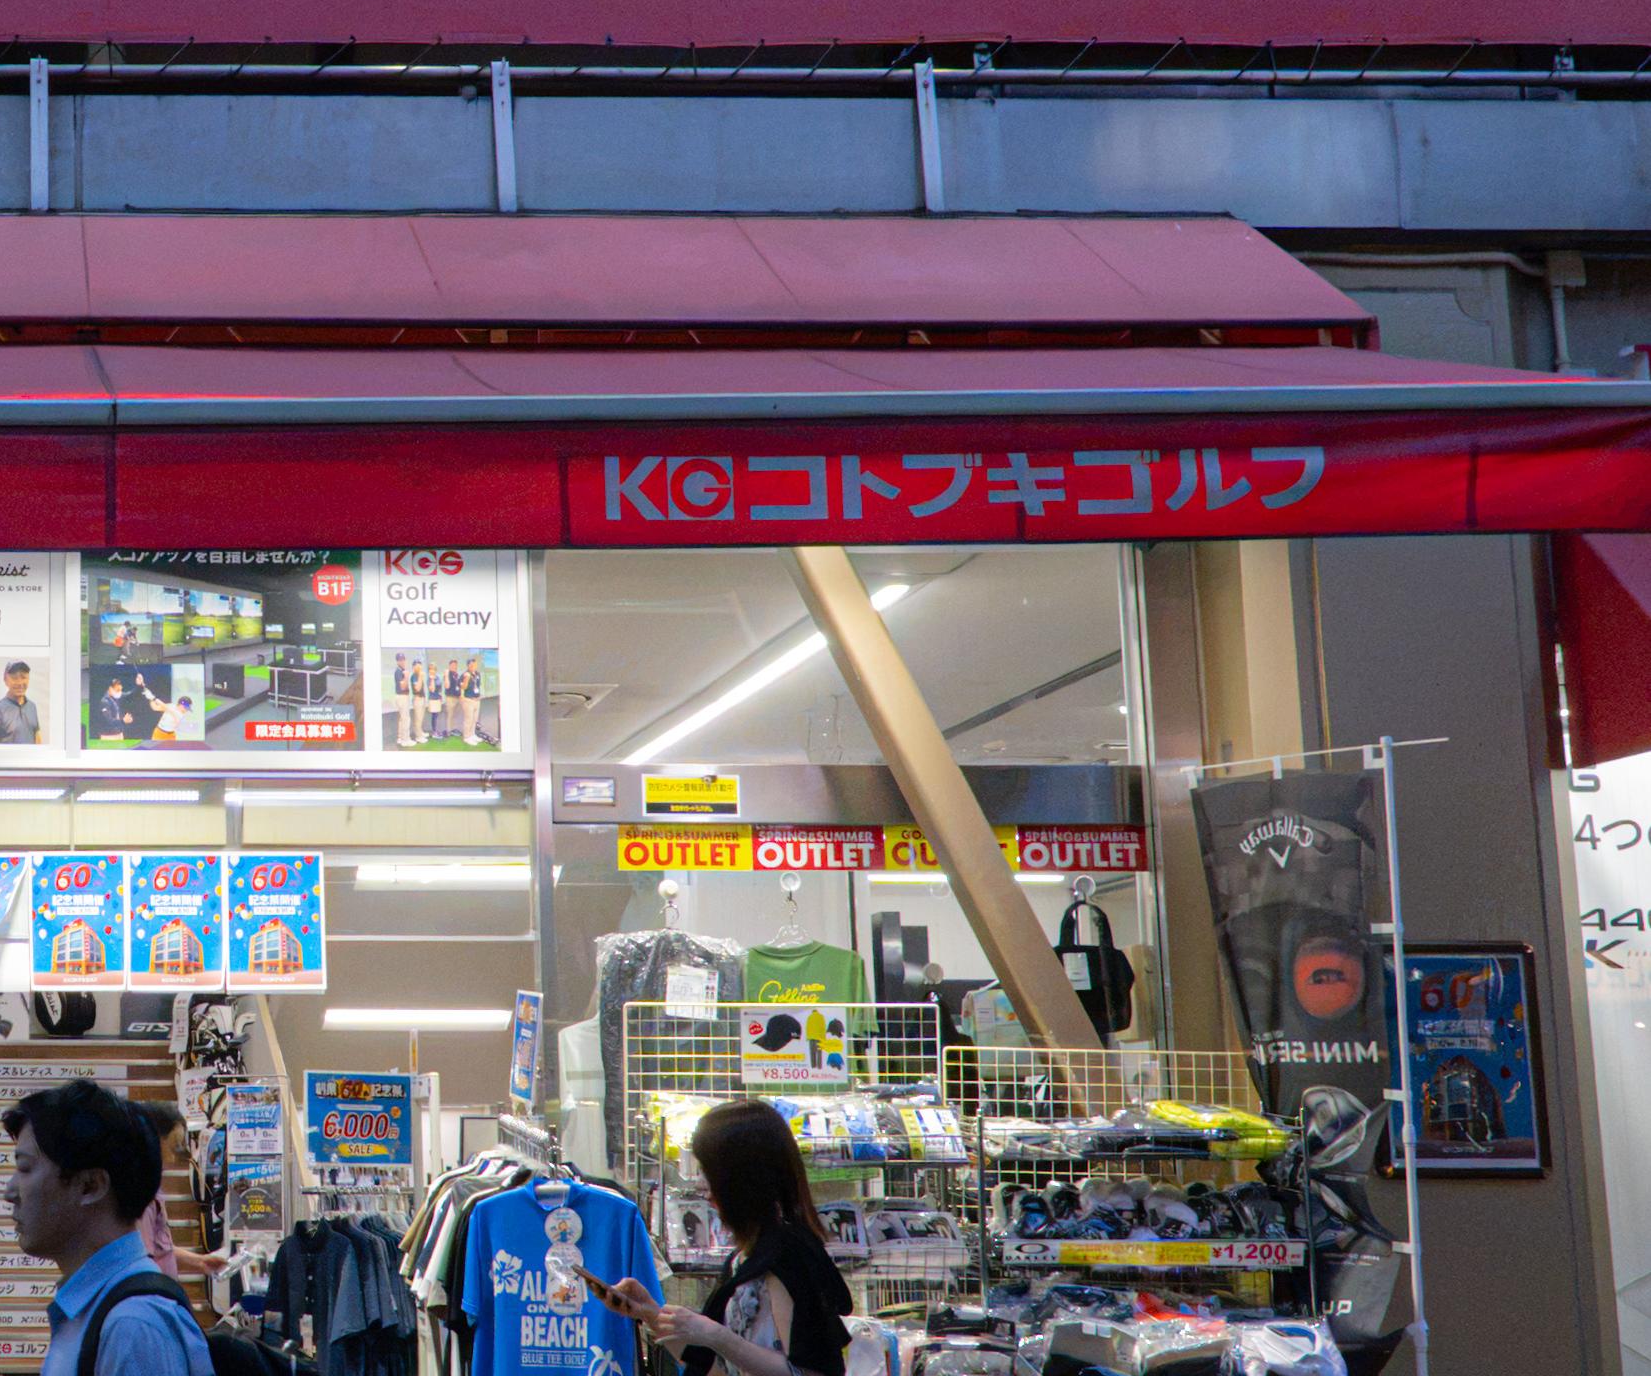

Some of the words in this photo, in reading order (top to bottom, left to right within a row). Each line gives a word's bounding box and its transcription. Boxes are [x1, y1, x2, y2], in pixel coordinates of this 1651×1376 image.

[603, 446, 1325, 521] KGコトブキゴルフ
[317, 582, 352, 596] B1F
[387, 582, 439, 601] Golf
[387, 606, 492, 630] Academy
[255, 725, 346, 739] 限定会員募集中
[1573, 814, 1651, 851] 4つ
[624, 841, 741, 866] OUTLET
[756, 841, 875, 868] OUTLET
[1023, 842, 1141, 868] OUTLET
[54, 863, 92, 892] 60
[152, 863, 190, 892] 60
[251, 864, 288, 892] 60
[347, 1144, 373, 1155] SALE
[520, 1315, 588, 1348] BEACH
[547, 1354, 562, 1365] TEE
[564, 1354, 587, 1366] GOLF
